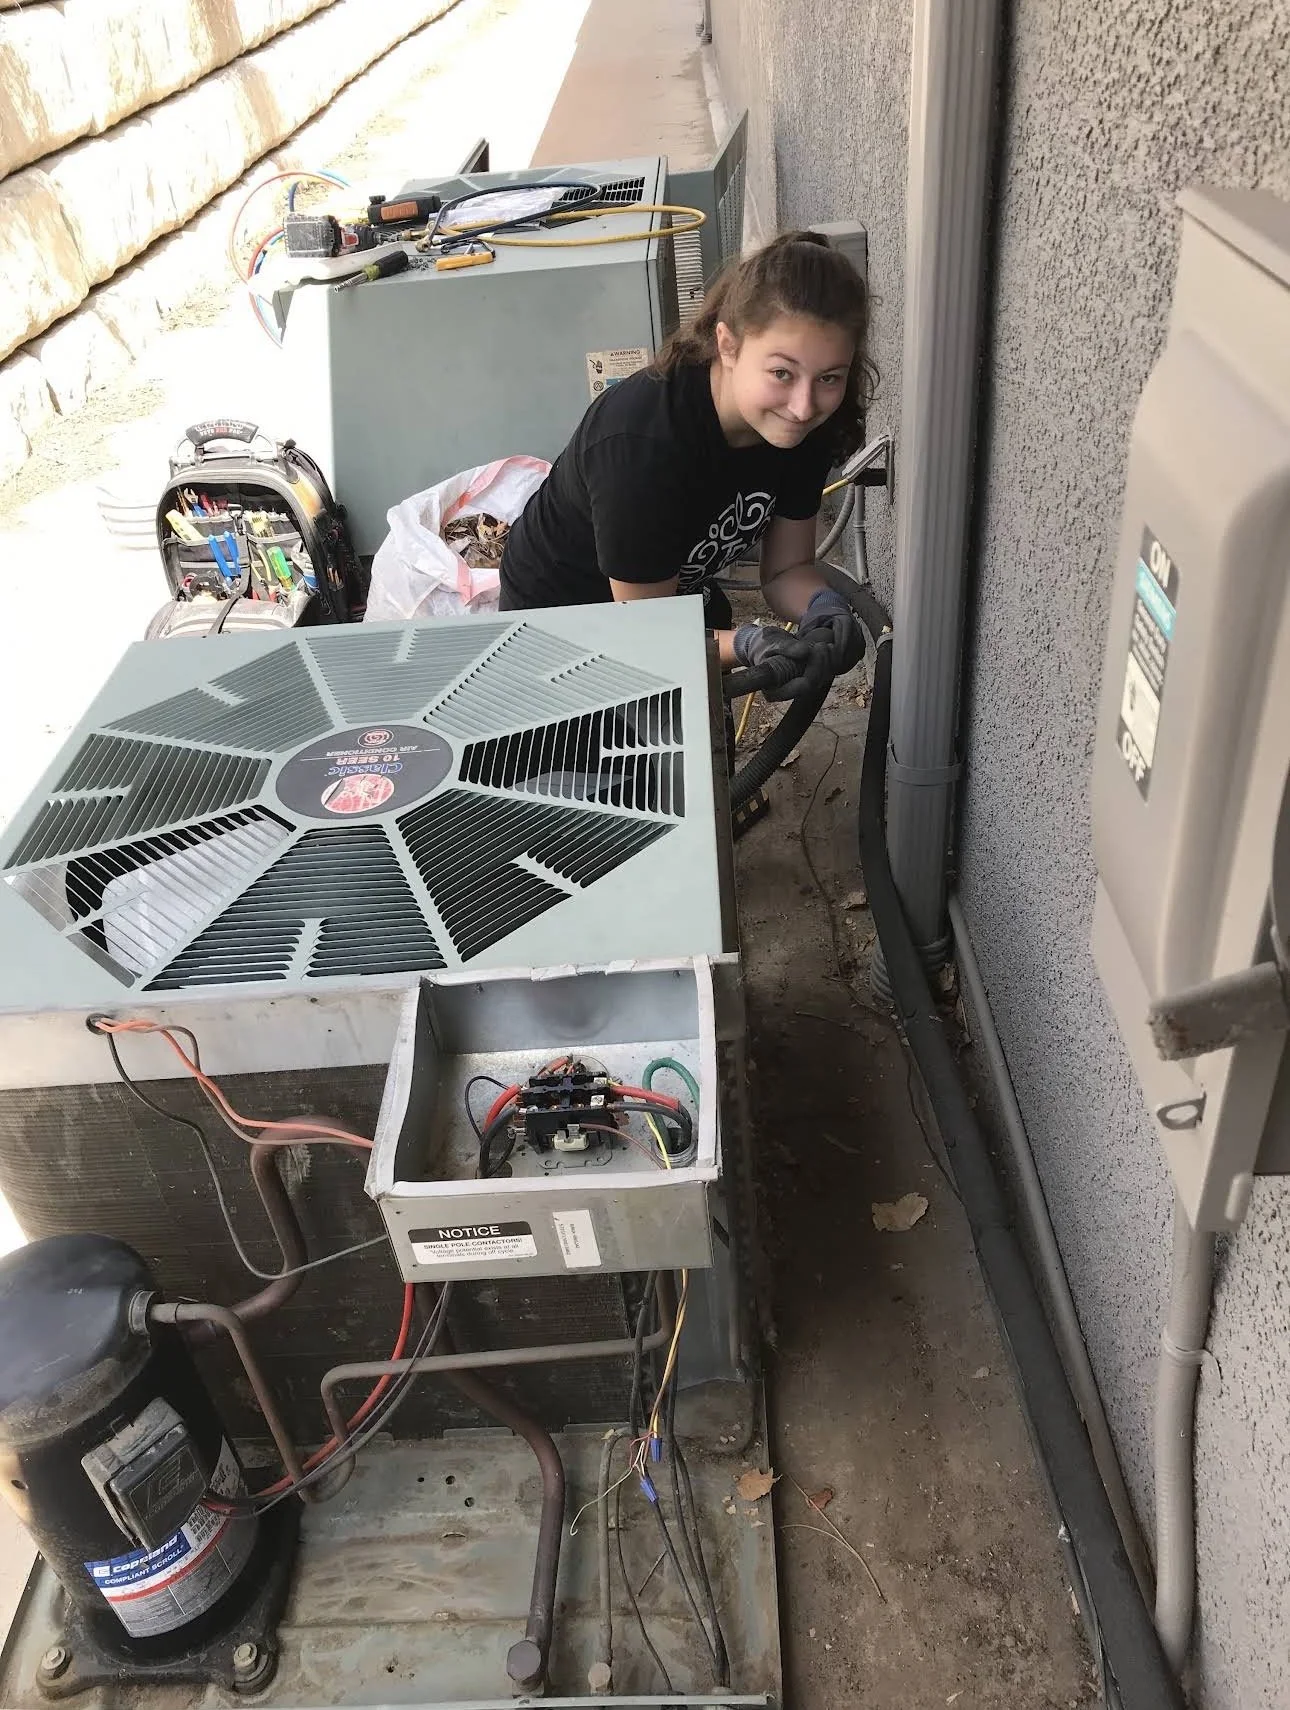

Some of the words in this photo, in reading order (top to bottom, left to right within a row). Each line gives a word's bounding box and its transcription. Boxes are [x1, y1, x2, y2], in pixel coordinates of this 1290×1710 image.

[1150, 541, 1171, 588] ON
[326, 747, 398, 757] CONDITIONER
[336, 754, 381, 765] SEER
[383, 754, 401, 763] 10
[1122, 731, 1147, 782] OFF
[328, 761, 404, 777] Classic
[438, 1225, 501, 1239] NOTICE
[104, 1567, 150, 1585] COMPLIANT
